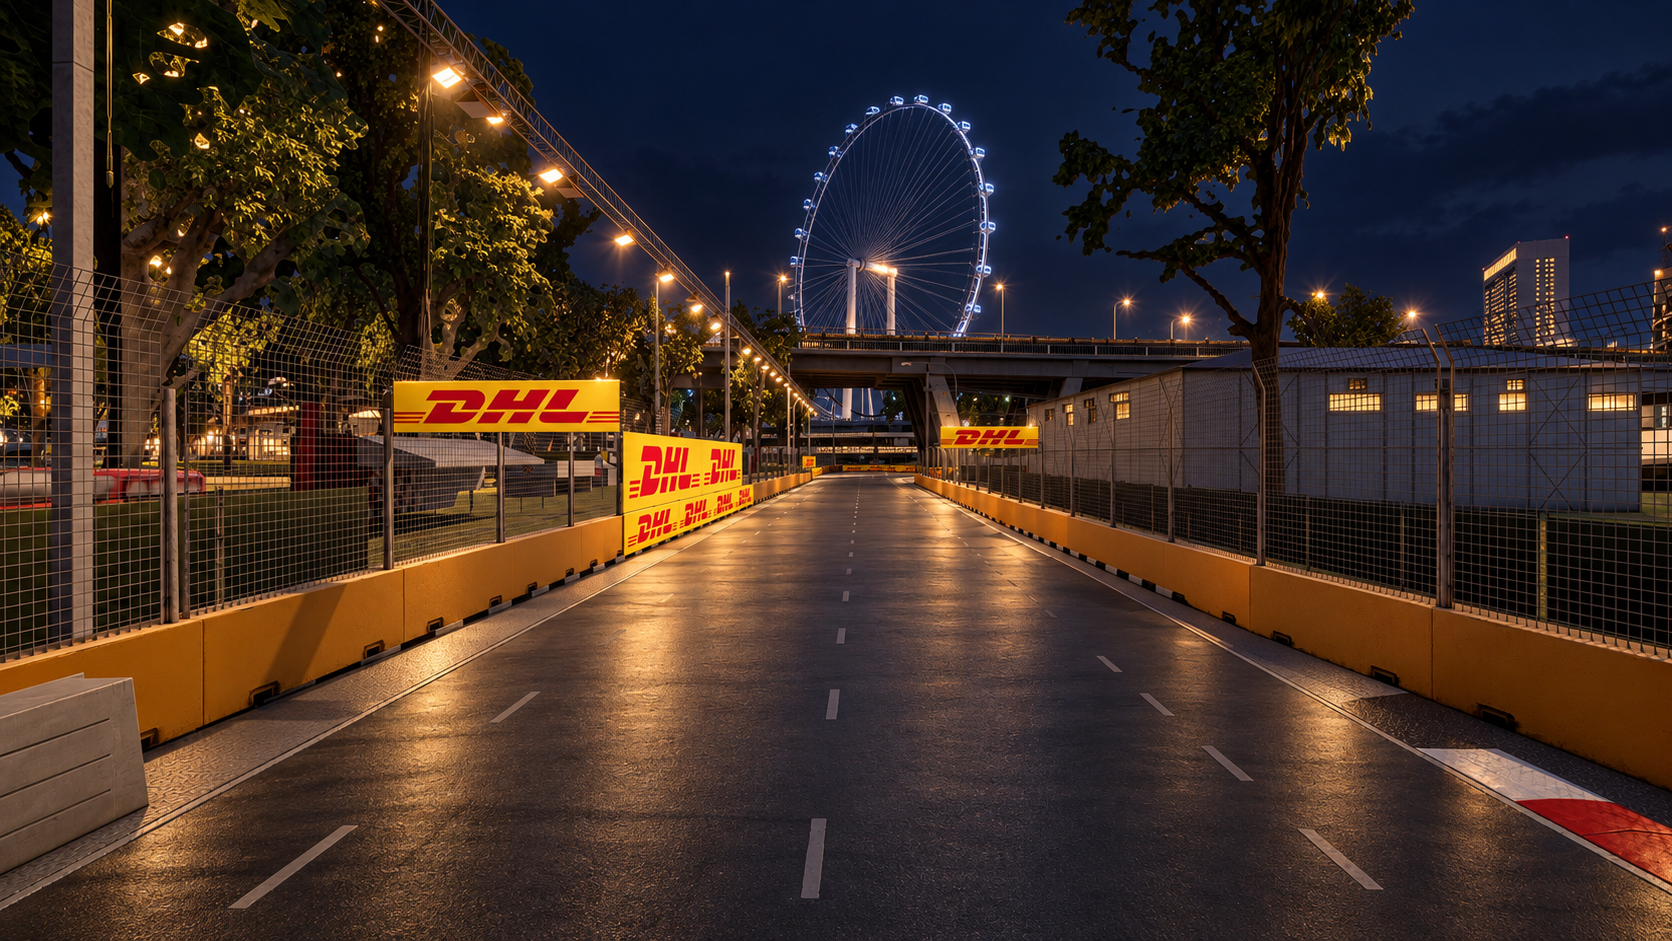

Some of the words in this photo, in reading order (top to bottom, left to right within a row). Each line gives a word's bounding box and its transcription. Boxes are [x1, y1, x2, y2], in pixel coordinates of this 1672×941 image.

[423, 389, 589, 424] DHL
[954, 429, 1025, 445] DHL
[640, 445, 692, 497] DHL
[710, 448, 737, 485] DHL
[637, 508, 672, 544] DHL
[684, 499, 708, 526] DHL
